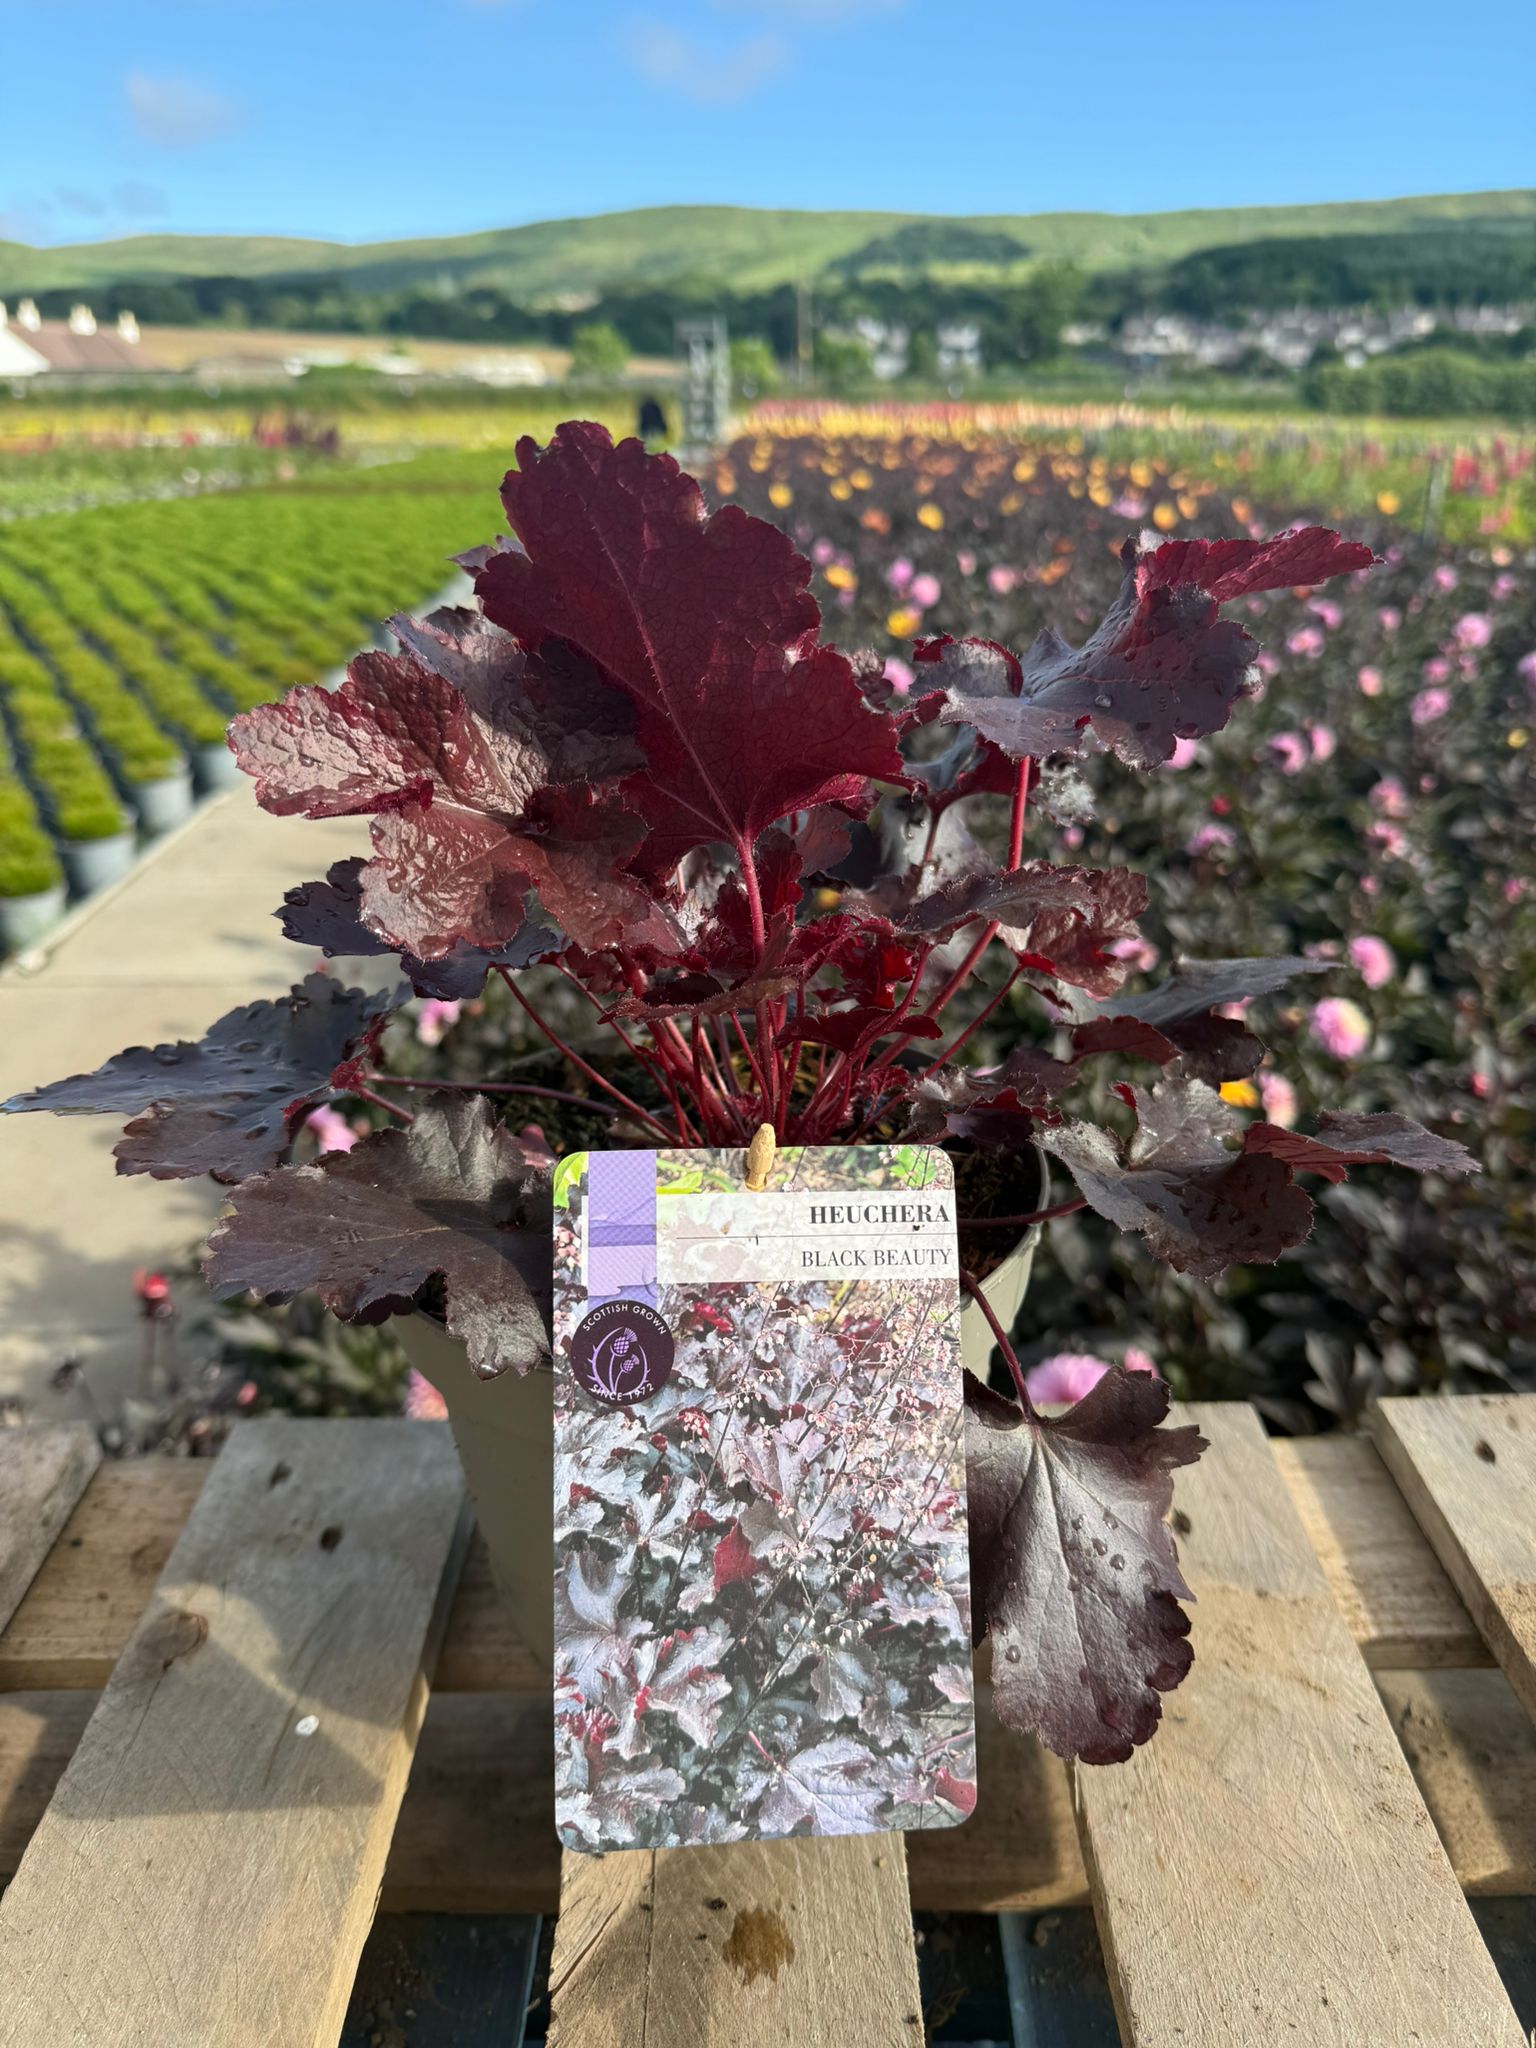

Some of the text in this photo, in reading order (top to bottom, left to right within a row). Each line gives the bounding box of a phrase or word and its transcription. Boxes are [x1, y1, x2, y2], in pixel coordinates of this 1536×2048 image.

[809, 1204, 950, 1224] HEUCHERA
[801, 1248, 952, 1267] BLACK BEAUTY
[583, 1304, 667, 1335] SCOTTISH GROWN
[590, 1383, 654, 1402] SINCE 1972
